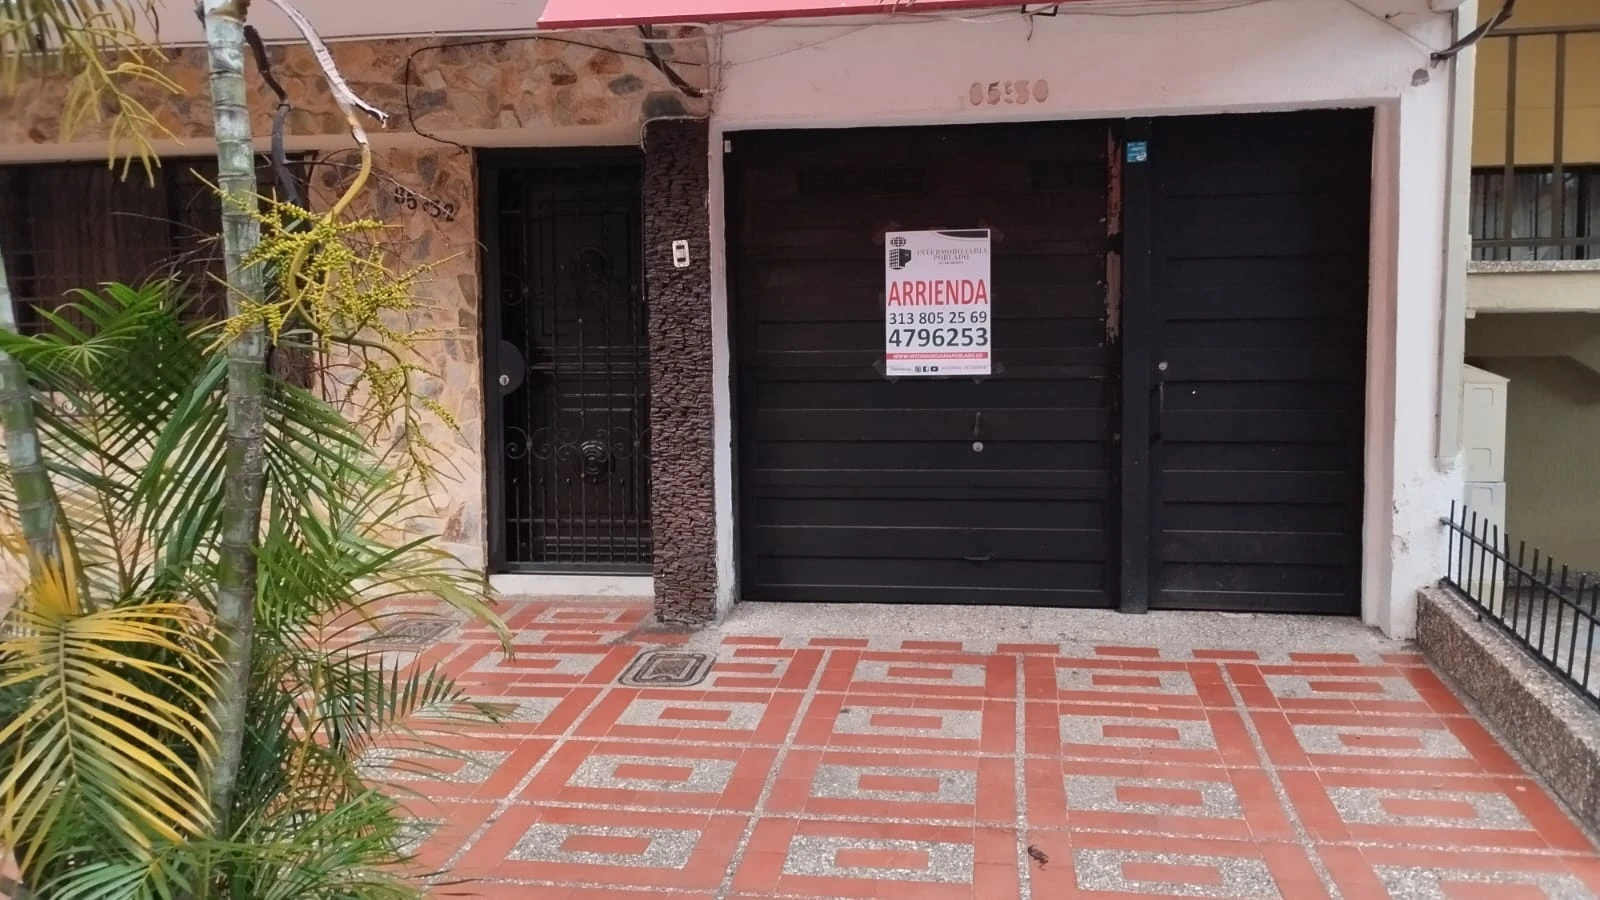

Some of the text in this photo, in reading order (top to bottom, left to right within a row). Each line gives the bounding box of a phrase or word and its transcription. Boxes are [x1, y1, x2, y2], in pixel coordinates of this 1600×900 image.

[933, 254, 970, 262] POBLADO
[888, 278, 989, 307] ARRIENDA
[889, 310, 987, 325] 313 805 25 69
[888, 327, 989, 348] 4796253
